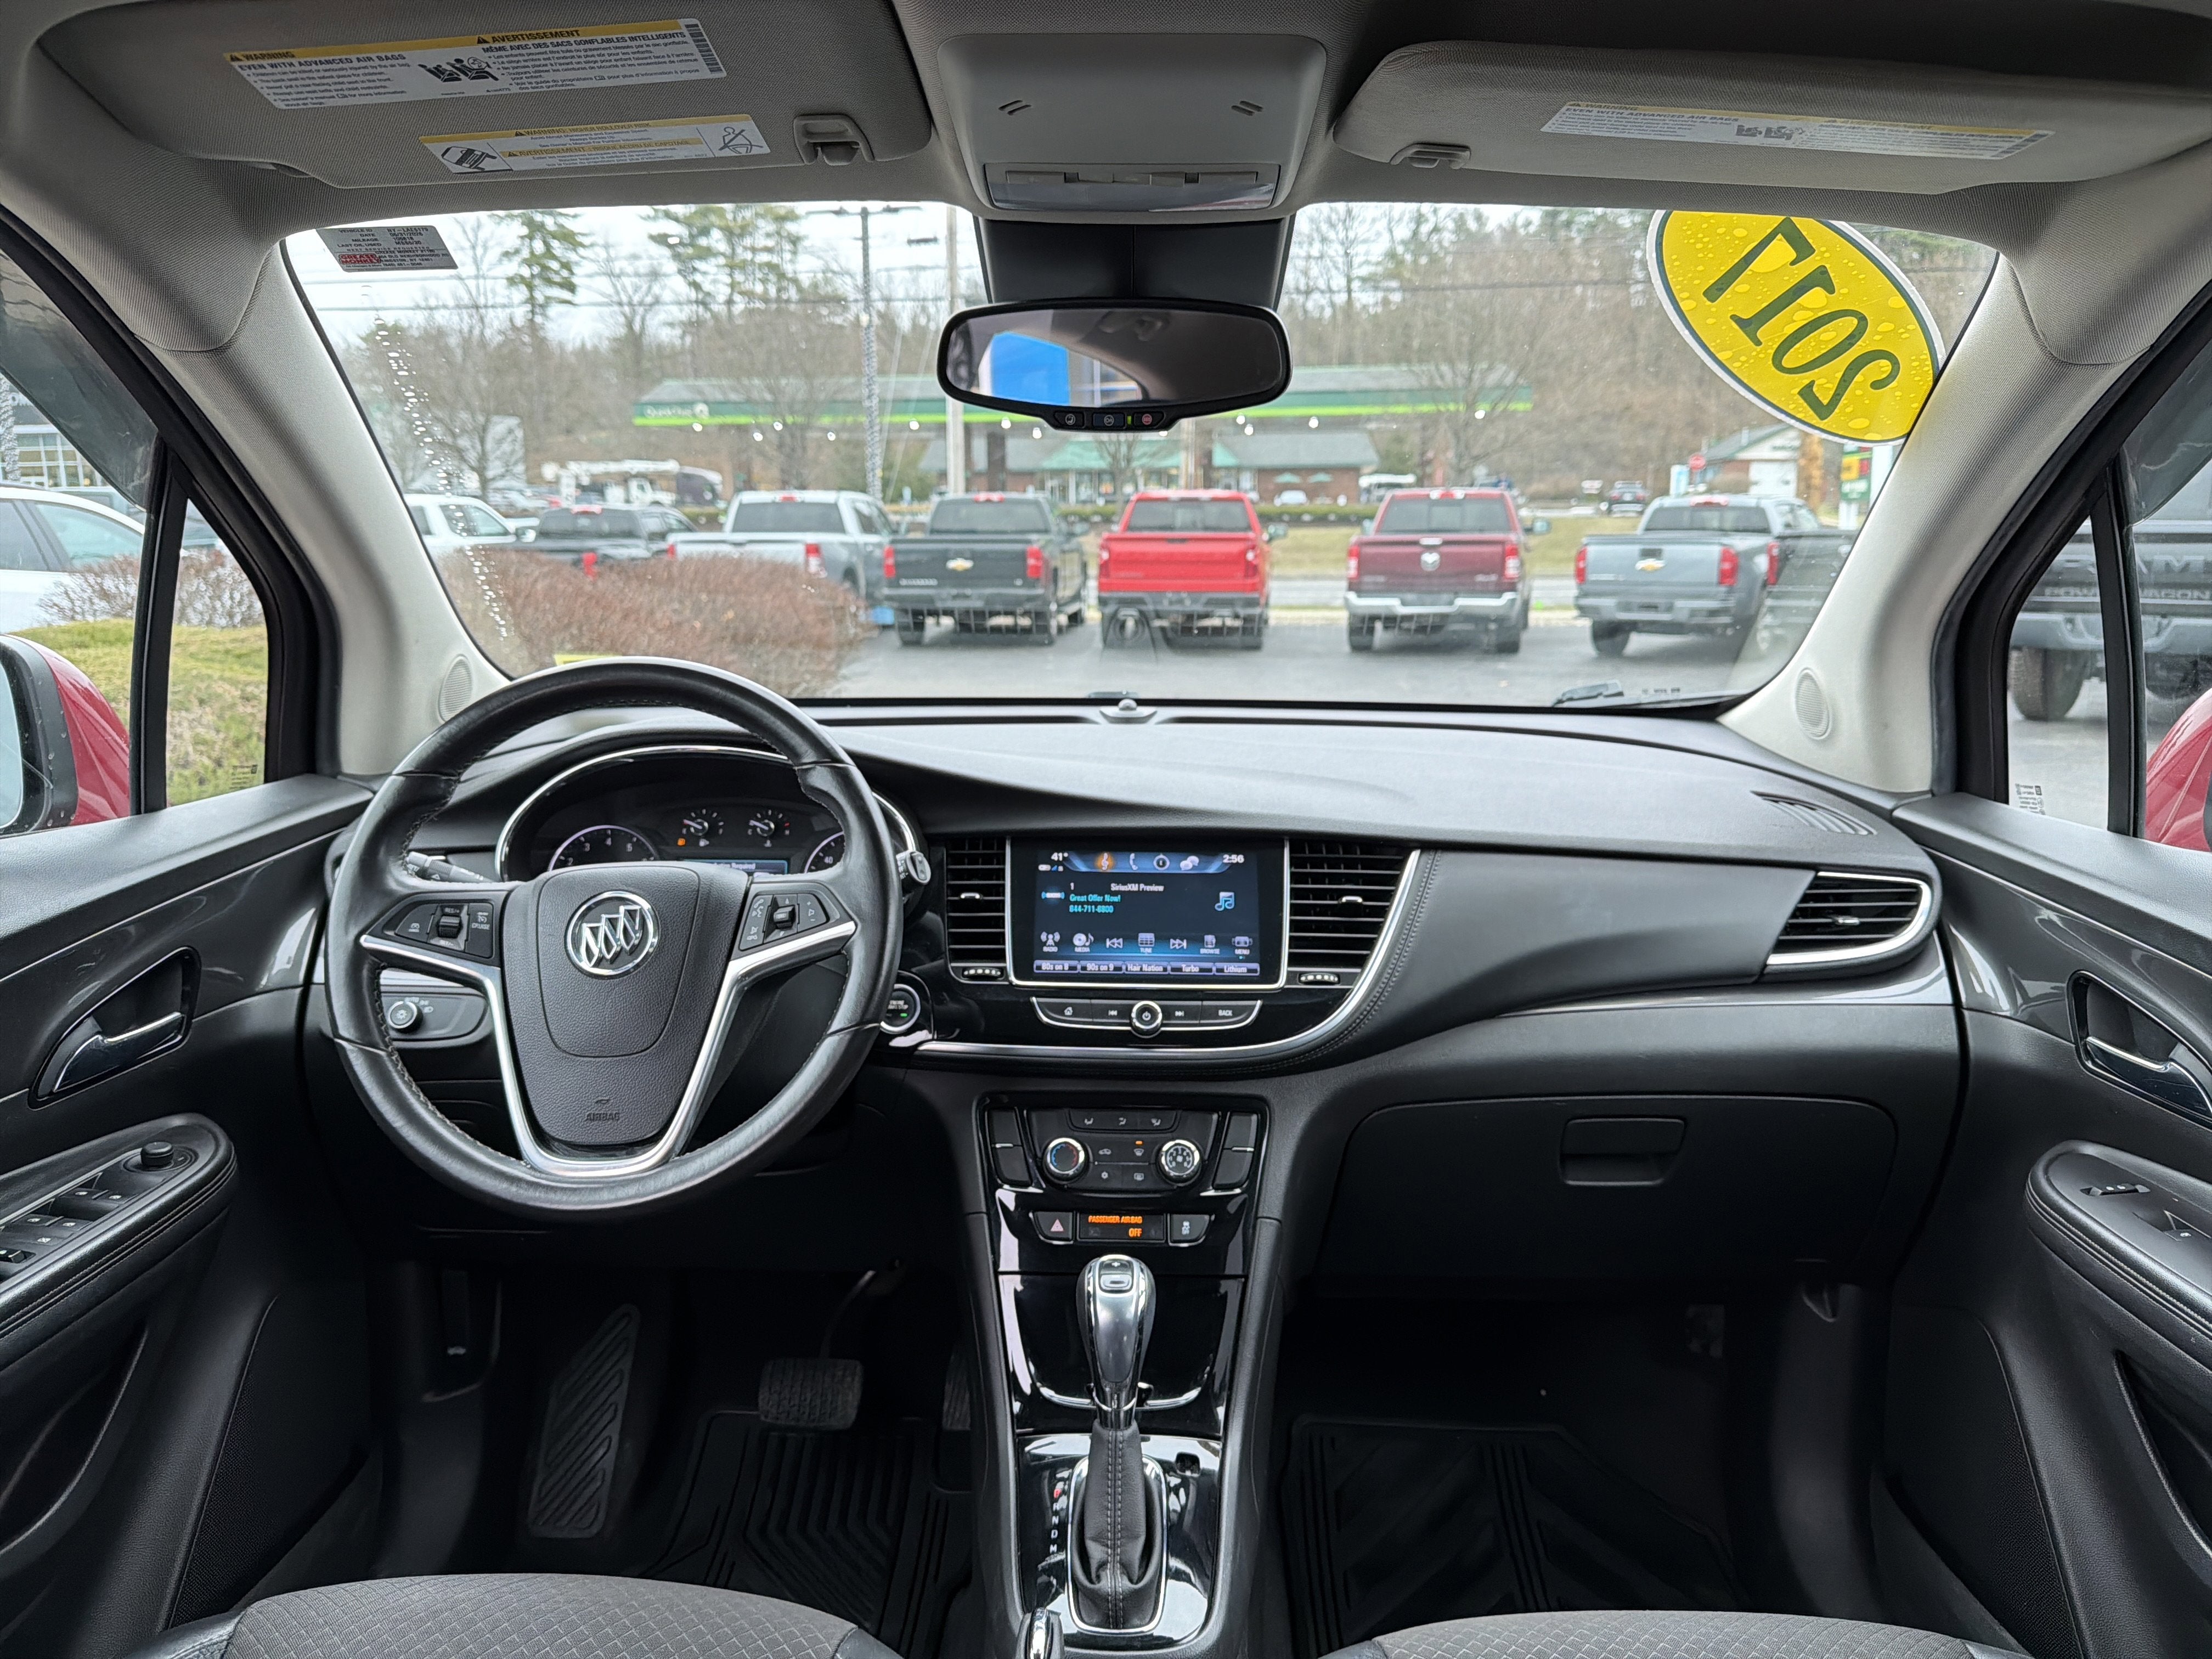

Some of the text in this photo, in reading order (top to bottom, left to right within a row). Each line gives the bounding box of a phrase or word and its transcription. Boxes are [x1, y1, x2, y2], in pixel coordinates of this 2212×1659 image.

[488, 30, 583, 43] AVERTISSEMENT
[572, 36, 627, 46] GONFLABLES
[627, 32, 687, 42] INTELLIGENTS
[241, 50, 296, 61] WARNING
[295, 57, 354, 66] ADVANCED
[605, 837, 612, 846] 4
[584, 843, 591, 852] 3
[825, 856, 833, 864] 40
[1051, 852, 1069, 861] 41°
[1223, 854, 1245, 864] 2:56
[1110, 883, 1164, 893] SiriusXM Preview
[1069, 894, 1087, 902] Great
[1088, 894, 1103, 902] Offer
[1104, 894, 1121, 902] Now!
[1086, 963, 1099, 971] 90s
[1127, 963, 1164, 972] Hair Nation
[1181, 964, 1200, 972] Turbo
[1224, 965, 1248, 973] Lithium
[584, 1112, 620, 1121] AIRBAG
[1088, 1215, 1120, 1223] PASSENGER
[1128, 1228, 1142, 1237] OFF
[1053, 1503, 1060, 1511] R
[1052, 1516, 1059, 1525] N
[1051, 1529, 1058, 1539] D
[1049, 1544, 1058, 1553] M
